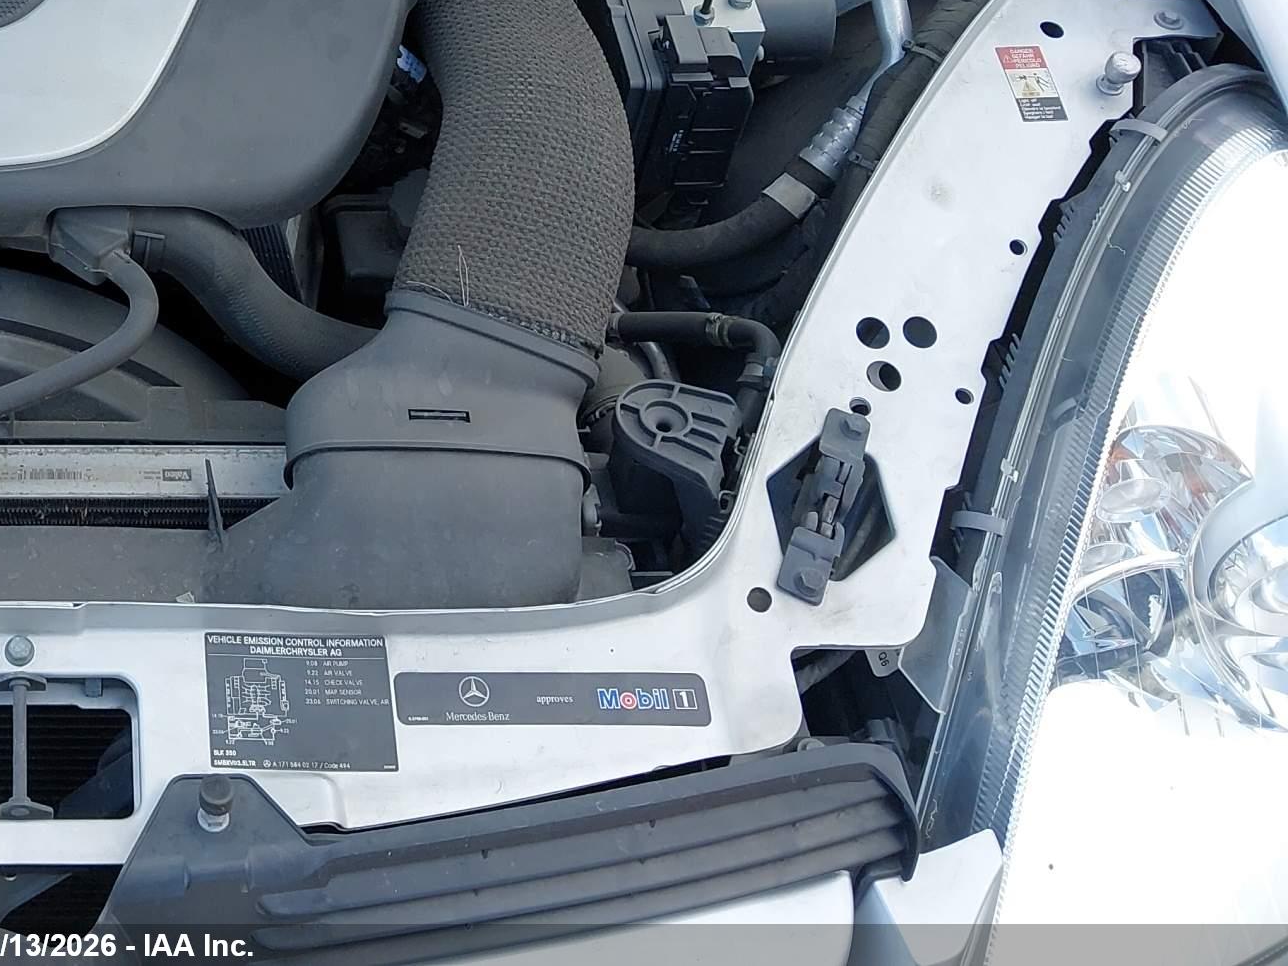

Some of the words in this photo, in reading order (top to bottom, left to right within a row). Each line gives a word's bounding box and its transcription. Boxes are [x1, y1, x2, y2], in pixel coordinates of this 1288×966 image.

[164, 471, 189, 480] Valeo
[207, 636, 242, 644] VEHICLE
[244, 637, 284, 645] EMISSION
[285, 638, 324, 647] CONTROL
[326, 639, 383, 647] INFORMATION
[250, 646, 328, 656] DAIMLERCHRYSLER
[330, 648, 342, 656] AG
[536, 694, 574, 705] approves
[597, 688, 670, 710] Mobil
[445, 711, 510, 721] Mercedes-Benz
